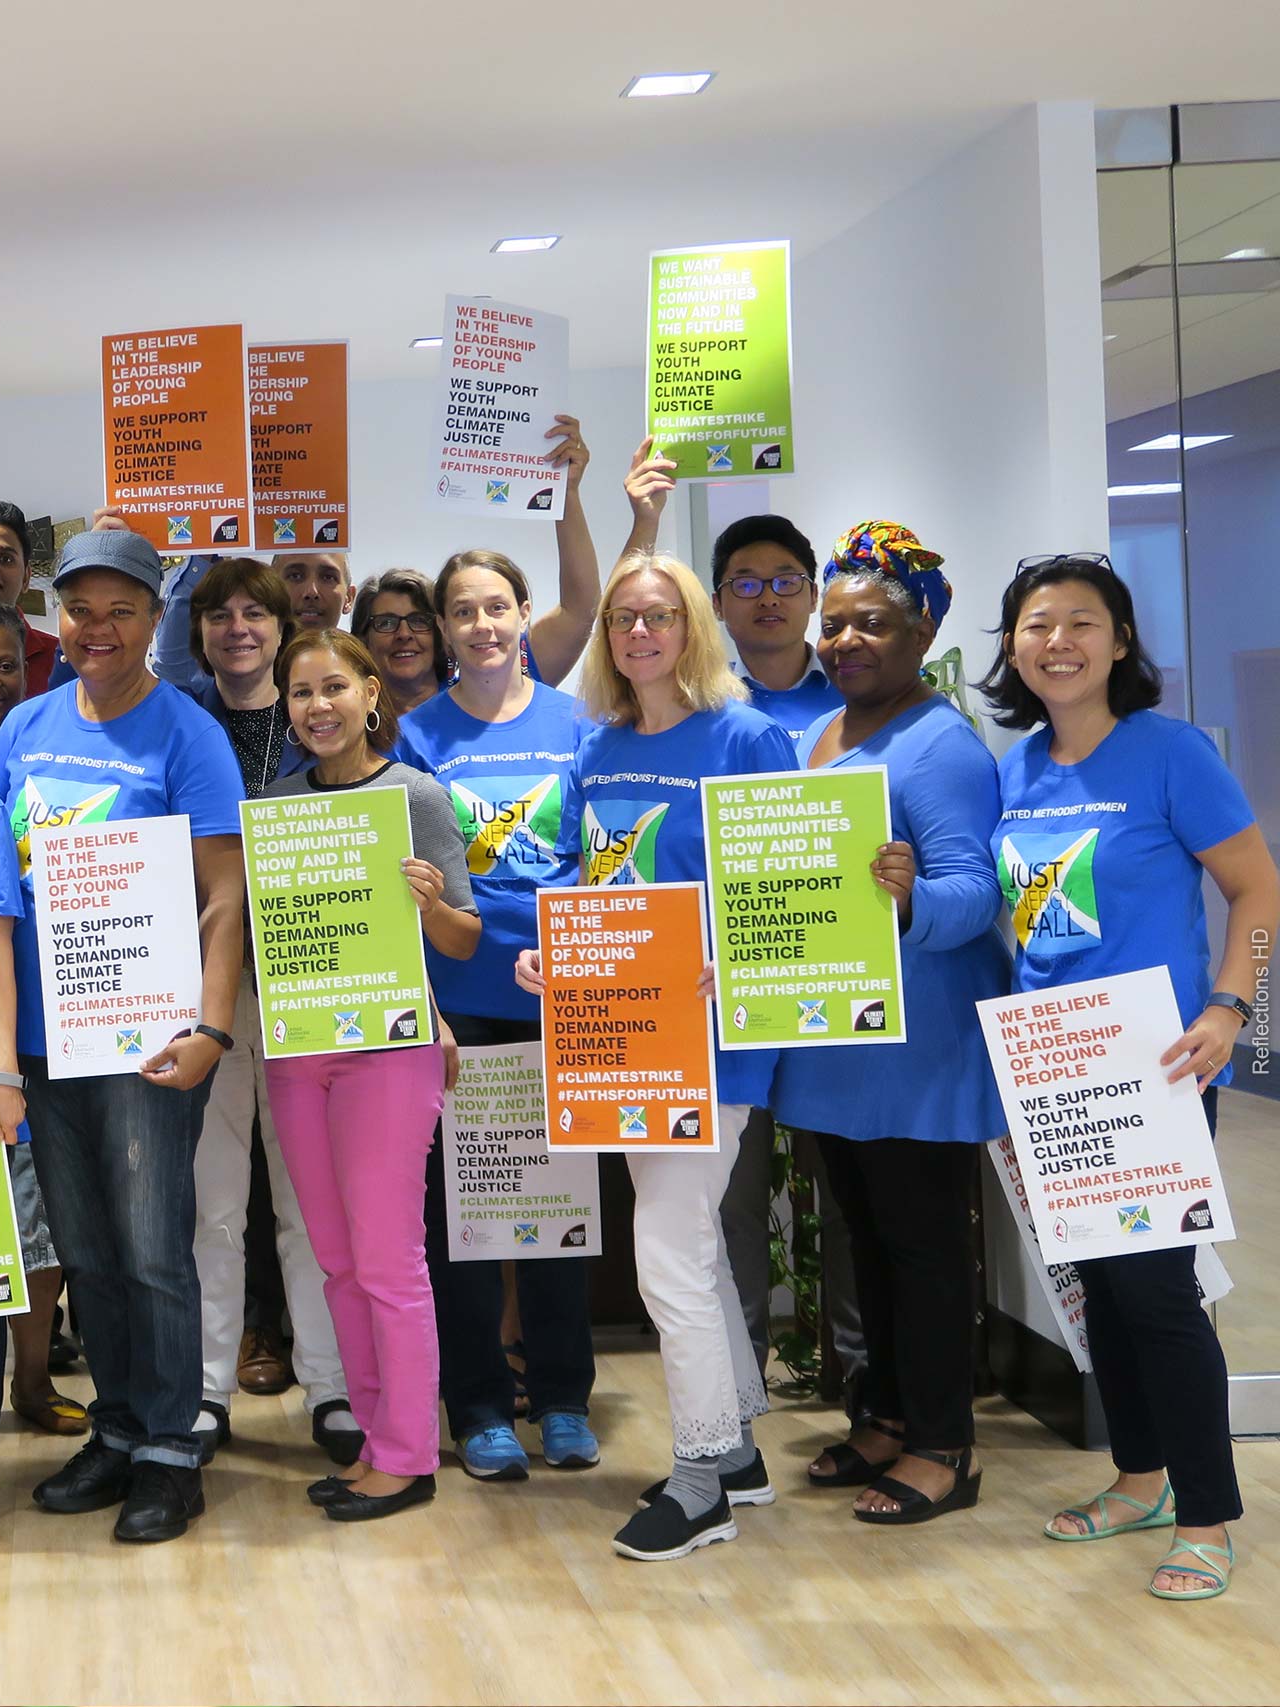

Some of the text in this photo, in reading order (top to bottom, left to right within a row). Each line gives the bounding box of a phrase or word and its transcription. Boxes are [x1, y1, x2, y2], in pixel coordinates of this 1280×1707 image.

[456, 305, 534, 329] WE BELIEVE
[455, 318, 500, 335] IN THE
[656, 338, 749, 355] WE SUPPORT
[250, 351, 305, 363] BELIEVE
[655, 355, 701, 370] YOUTH
[655, 368, 742, 384] DEMANDING
[251, 424, 312, 435] SUPPORT
[114, 482, 225, 500] #CLIMATESTRIKE
[21, 752, 145, 775] UNITED METHODIST WOMEN
[434, 751, 575, 774] UNITED METHODIST WOMEN
[658, 775, 698, 790] WOMEN
[22, 801, 83, 827] JUST
[469, 800, 531, 824] JUST
[1002, 802, 1127, 820] NITED METHODIST WOMEN
[251, 813, 371, 839] SUSTAINABLE
[462, 825, 541, 843] ENERGY
[253, 830, 379, 856] COMMUNITIES
[586, 828, 638, 855] JUST
[254, 848, 363, 874] NOW AND IN
[486, 843, 550, 864] 4ALL
[1010, 861, 1063, 889] JUST
[722, 875, 844, 897] WE SUPPORT
[724, 895, 787, 913] YOUTH
[50, 914, 155, 936] WE SUPPORT
[726, 909, 838, 930] DEMANDING
[1027, 911, 1085, 938] 4ALL
[52, 933, 106, 951] YOUTH
[550, 929, 655, 947] LEADERSHIP
[550, 945, 637, 963] OF YOUNG
[551, 962, 617, 979] PEOPLE
[1033, 1135, 1116, 1161] CLIMATE
[456, 1153, 550, 1168] DEMANDING
[1037, 1151, 1117, 1177] JUSTICE
[457, 1168, 524, 1181] CLIMATE
[1042, 1161, 1184, 1194] #CLIMATESTRIKE
[458, 1181, 523, 1194] JUSTICE
[1047, 1175, 1213, 1212] #FAITHSFORFUTURE
[459, 1193, 573, 1207] #CLIMATESTRIKE
[460, 1206, 592, 1221] #FAITHSFORFUTURE
